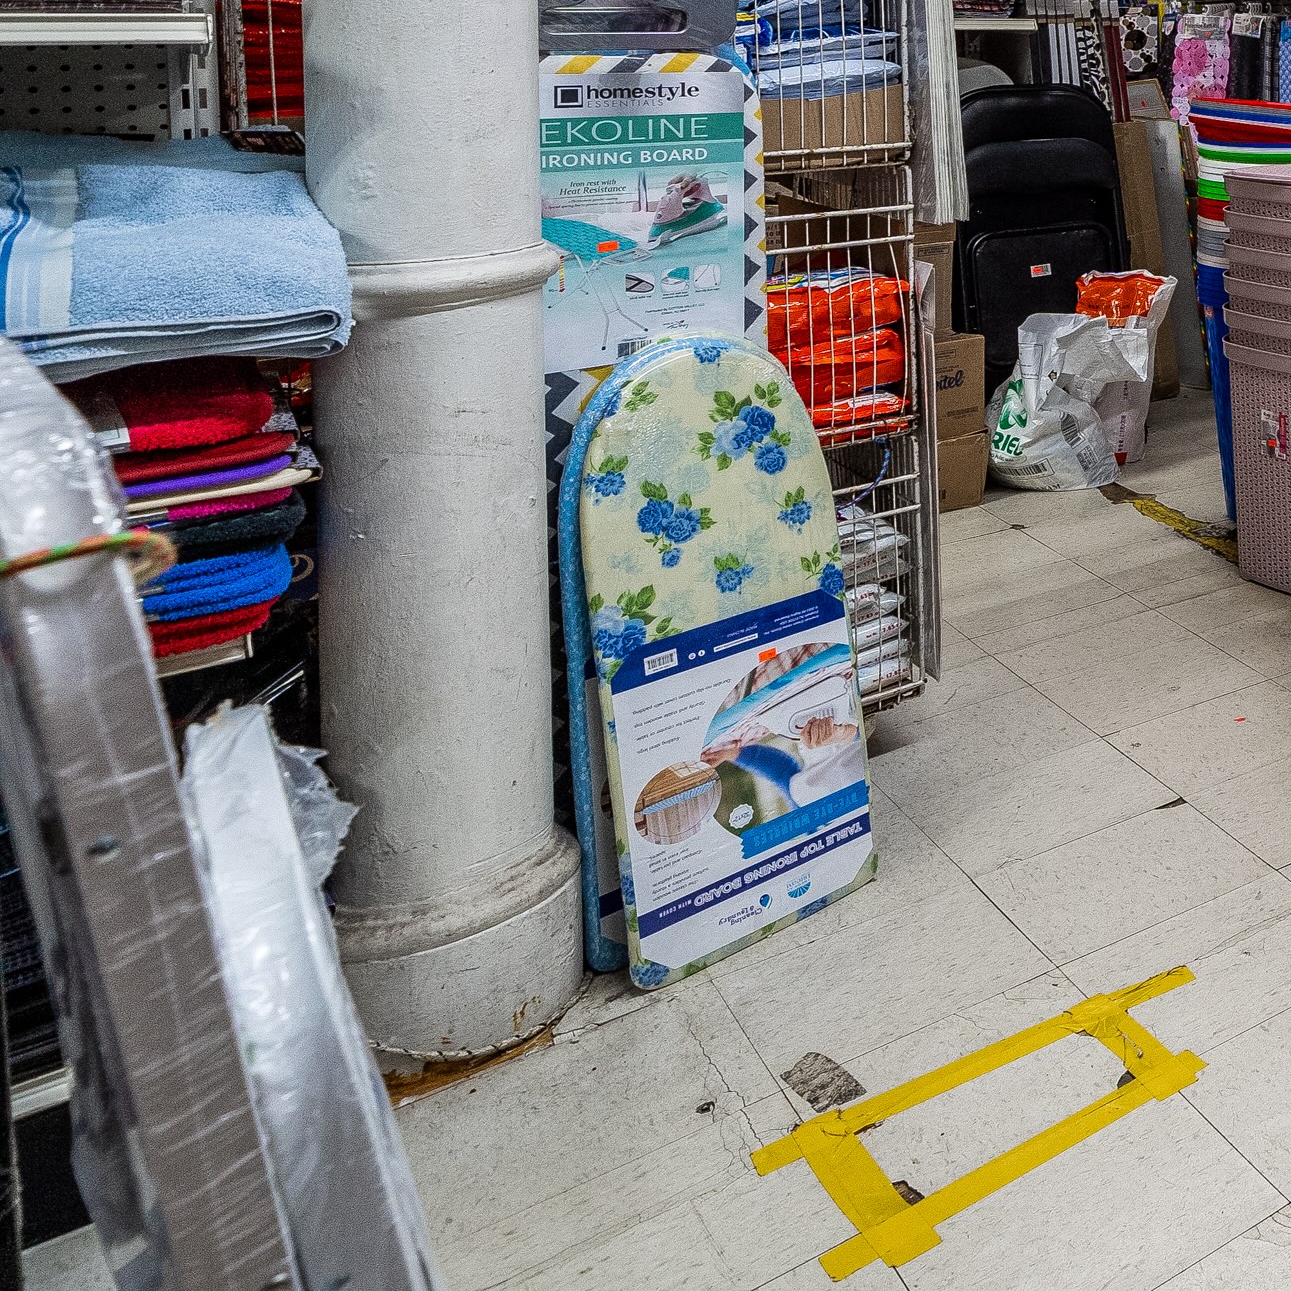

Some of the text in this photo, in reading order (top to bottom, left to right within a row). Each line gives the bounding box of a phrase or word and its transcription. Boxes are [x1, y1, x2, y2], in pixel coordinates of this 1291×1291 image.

[586, 82, 700, 102] homestyle
[587, 99, 664, 109] ESSENTIALS
[541, 116, 708, 145] EKOLINE
[541, 148, 708, 168] IRONING BOARD
[559, 184, 627, 196] Heat Resistance
[570, 178, 617, 188] Iron rest with
[825, 821, 863, 846] TABLE
[800, 840, 824, 859] TOP
[744, 852, 797, 883] IRONING
[693, 877, 742, 907] BOARD
